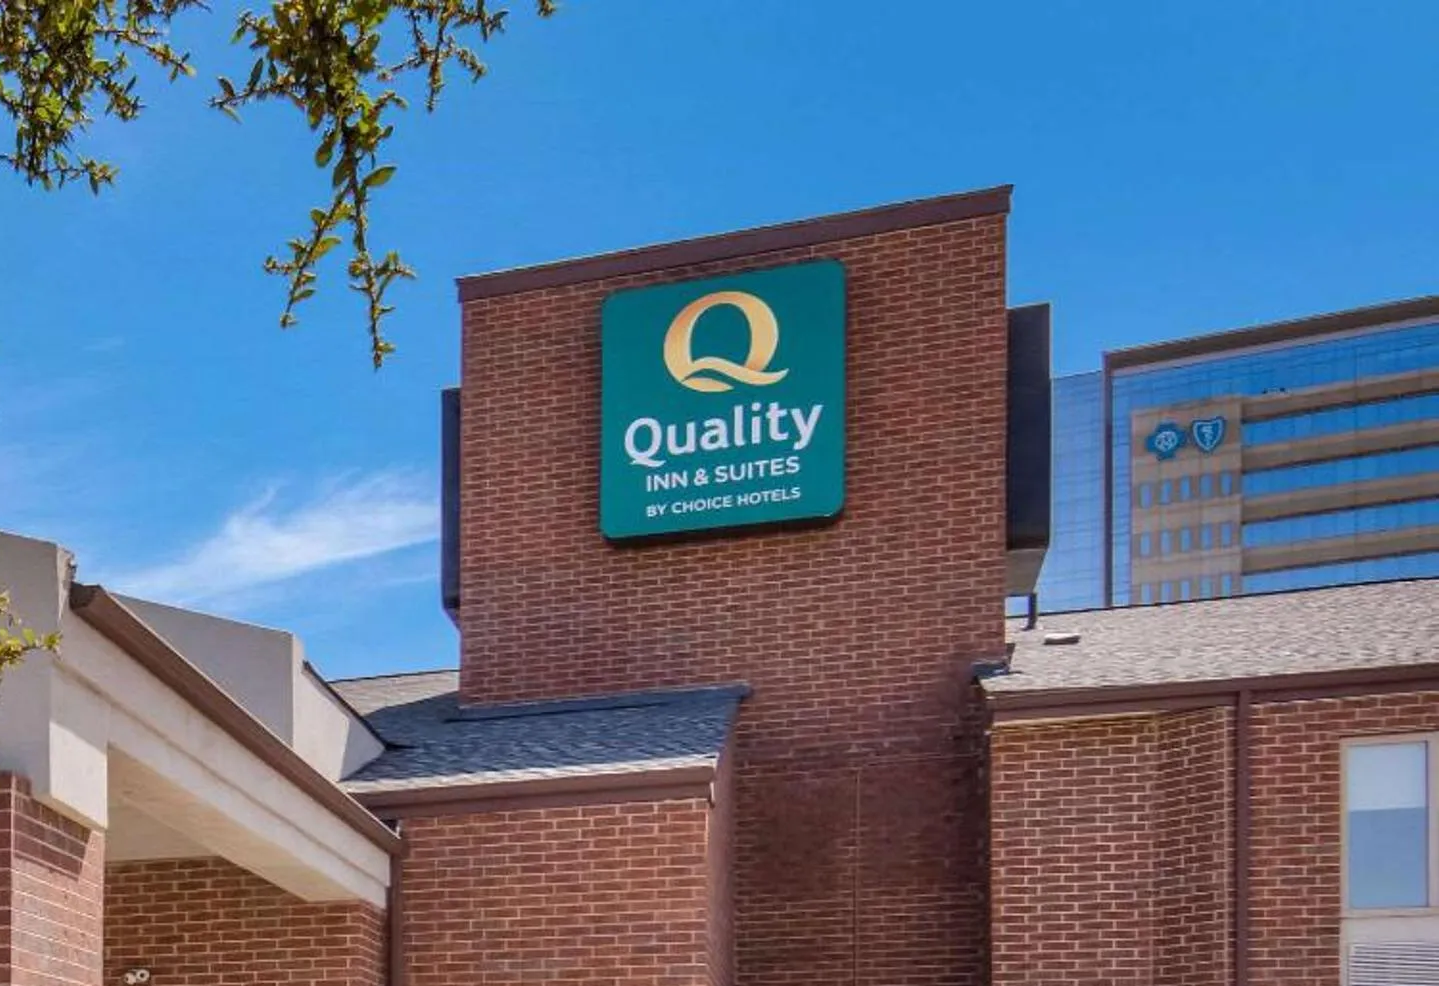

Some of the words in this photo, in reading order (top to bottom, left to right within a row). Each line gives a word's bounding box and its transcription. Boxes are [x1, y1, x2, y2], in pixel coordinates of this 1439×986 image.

[663, 290, 789, 393] Q
[624, 402, 823, 467] Quality
[646, 470, 688, 492] INN
[693, 467, 709, 486] &
[714, 456, 800, 483] SUITES
[646, 504, 667, 517] BY
[671, 494, 733, 514] CHOICE
[737, 486, 801, 507] HOTELS
